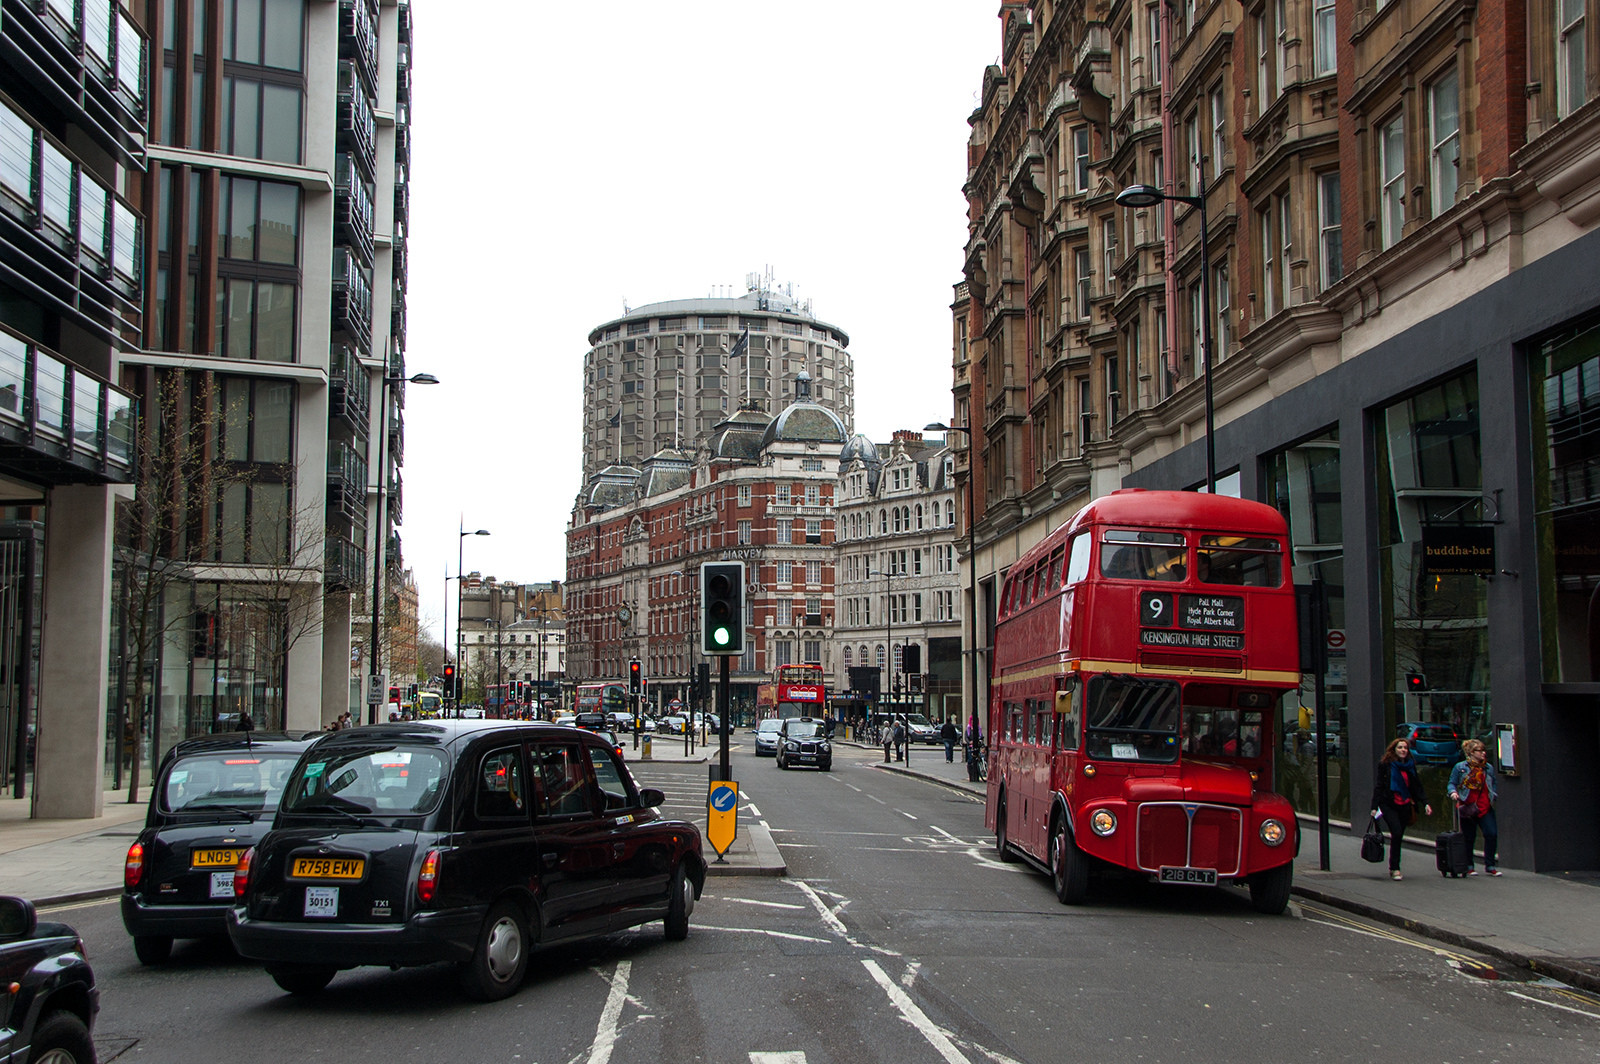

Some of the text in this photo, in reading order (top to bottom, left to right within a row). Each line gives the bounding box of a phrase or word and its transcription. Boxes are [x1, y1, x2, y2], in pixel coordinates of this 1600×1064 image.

[723, 549, 762, 560] HARVEY
[1426, 545, 1492, 555] buddha-bar
[1149, 598, 1164, 619] 9
[1198, 598, 1224, 608] Pall Mall
[1188, 607, 1234, 617] Hyde Park Corner
[1186, 616, 1235, 627] Royal Albert Hall
[1143, 631, 1240, 648] KENSINGTON HIGH STREET
[1250, 694, 1258, 706] 9
[198, 851, 232, 864] LN09
[298, 860, 359, 875] R758 EMV
[1166, 870, 1210, 882] 218 CLT
[309, 897, 334, 907] 30151
